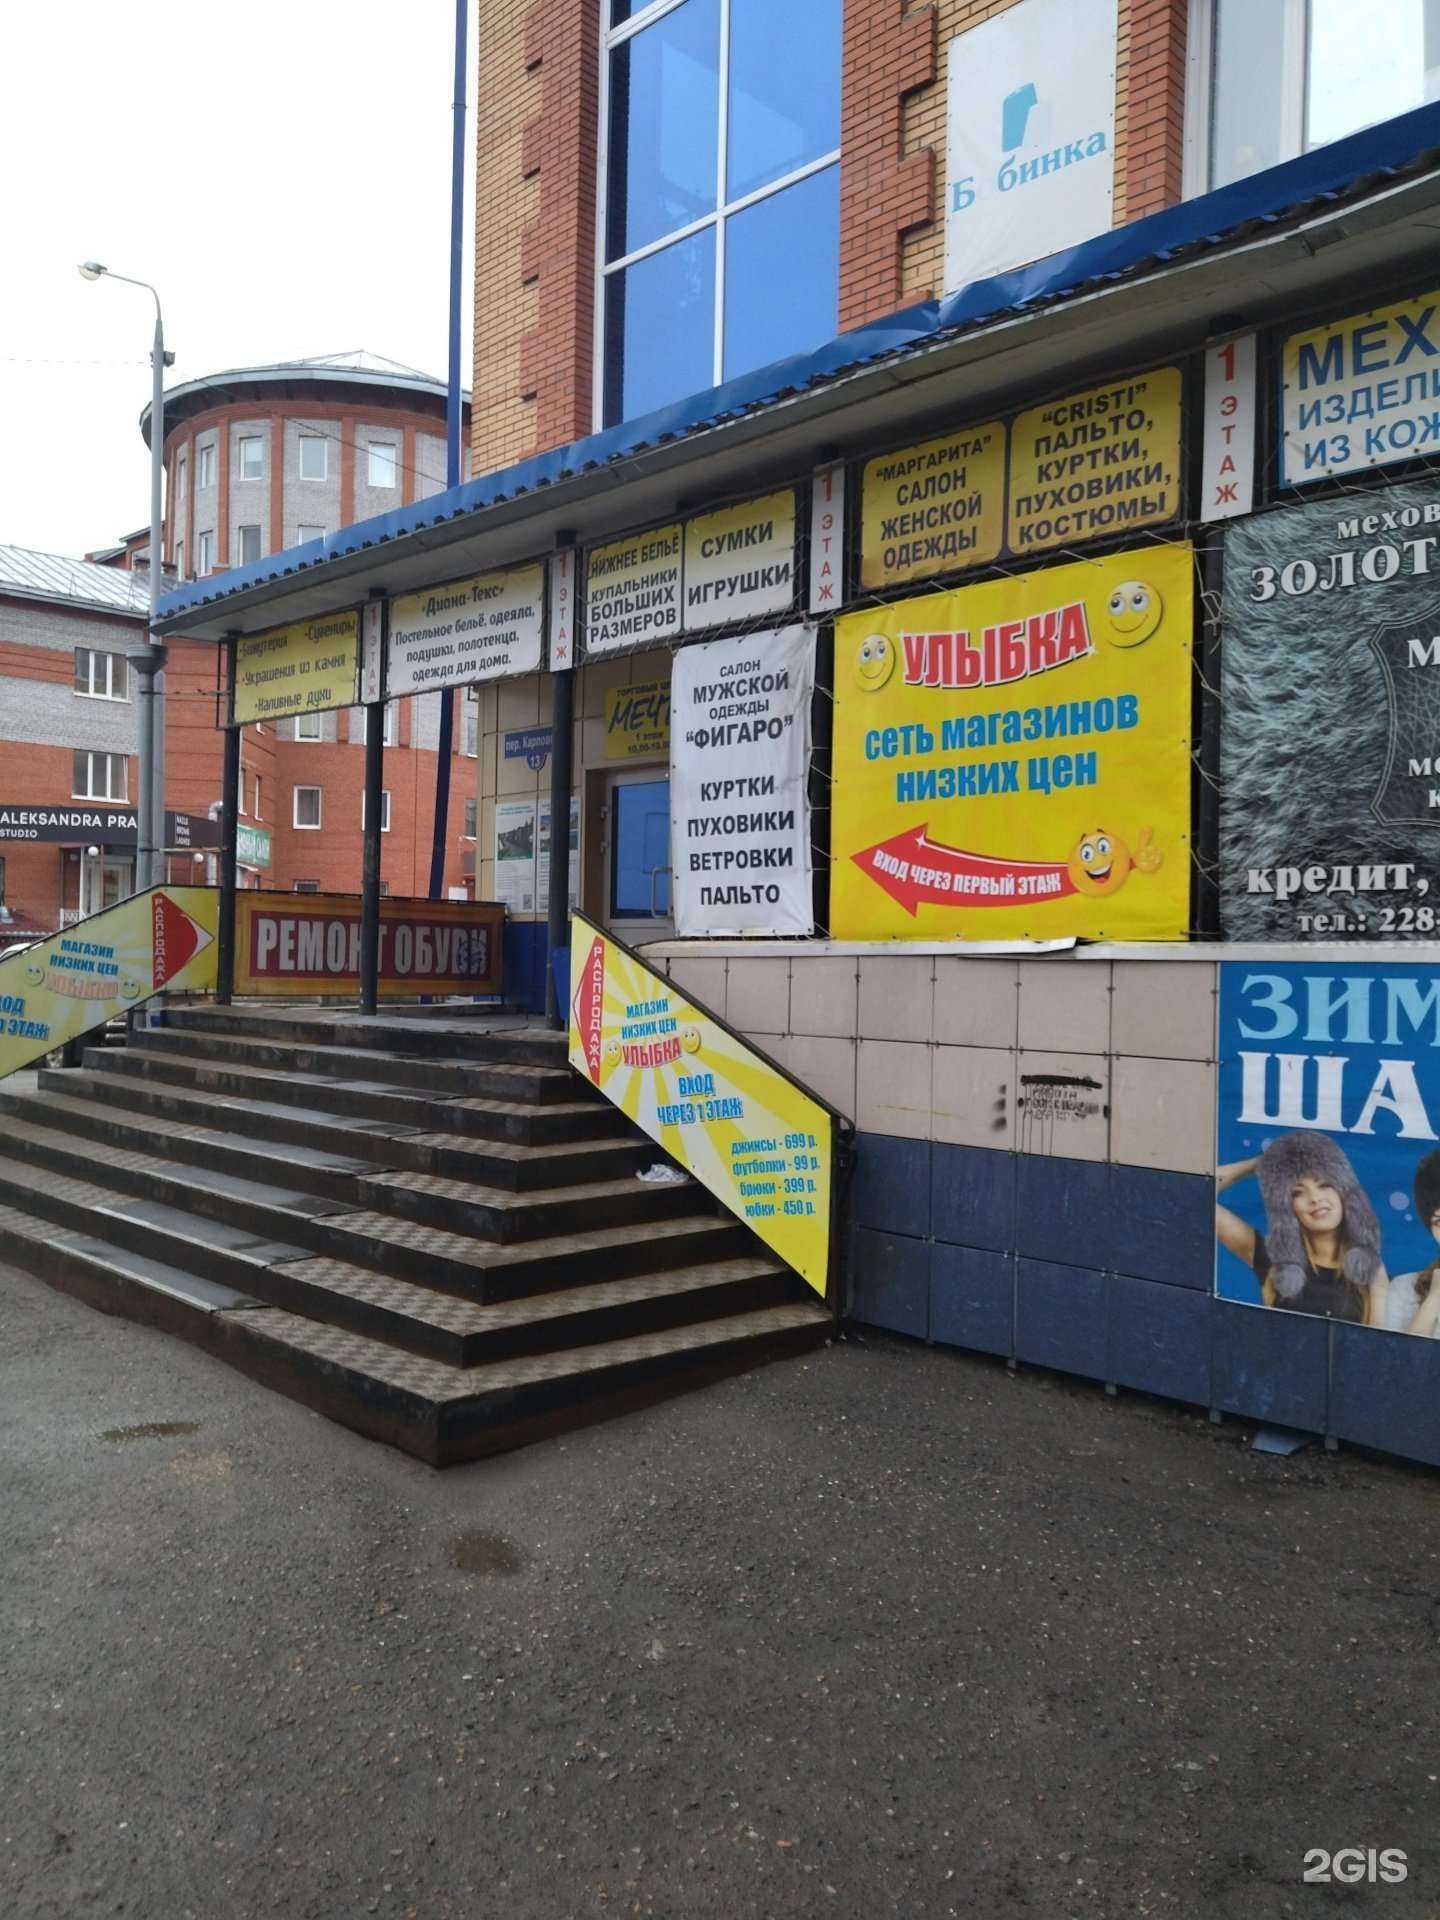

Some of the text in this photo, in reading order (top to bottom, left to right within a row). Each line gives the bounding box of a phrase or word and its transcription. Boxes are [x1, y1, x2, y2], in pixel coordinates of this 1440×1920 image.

[1035, 409, 1153, 458] ПАЛЬТО,
[1215, 343, 1239, 506] 1 ЭТАЖ
[1037, 438, 1148, 484] КУРТКИ,
[1304, 434, 1350, 470] ИЗ
[896, 467, 966, 505] САЛОН
[1015, 462, 1171, 517] ПУХОВИКИ,
[881, 488, 982, 540] ЖЕНСКОЙ
[1019, 492, 1166, 545] КОСТЮМЫ
[701, 520, 774, 559] СУМКИ
[818, 471, 833, 601] 1 ЭТАЖ
[883, 526, 977, 570] ОДЕЖДЫ
[591, 535, 680, 577] НИЖНЕЕ БЕЛЬЁ
[591, 567, 678, 604] КУПАЛЬНИКИ
[688, 562, 790, 606] ИГРУШКИ
[591, 585, 675, 623] БОЛЬШИХ
[395, 623, 453, 646] Постельное
[556, 587, 568, 660] ЭТАЖ
[590, 607, 677, 642] РАЗМЕРОВ
[901, 603, 1093, 687] УЛЫБКА
[300, 661, 310, 674] из
[412, 653, 511, 682] одежда для дома.
[719, 660, 761, 677] САЛОН
[306, 687, 332, 708] духи
[693, 668, 789, 704] МУЖСКОЙ
[709, 699, 770, 721] ОДЕЖДЫ
[865, 694, 1139, 760] сеть магазинов
[700, 776, 775, 801] КУРТКИ
[896, 751, 1097, 803] низких цен
[0, 811, 102, 827] ALEKSANDRA
[0, 828, 38, 838] STUDIO
[687, 810, 795, 837] ПУХОВИКИ
[689, 847, 793, 871] ВЕТРОВКИ
[871, 849, 1061, 896] ВХОД ЧЕРЕЗ ПЕРВЫЙ ЭТАЖ
[700, 884, 780, 905] ПАЛЬТО
[1246, 863, 1430, 900] кредит,
[1297, 913, 1367, 932] тел.:
[50, 954, 119, 977] НИЗКИХ ЦЕН
[60, 939, 114, 959] МАГАЗИН
[589, 946, 602, 1069] РАСПРОДАЖА
[626, 998, 669, 1018] МАГАЗИН
[1237, 974, 1440, 1047] ЗИМ
[7, 1018, 49, 1041] ЭТАЖ
[621, 1017, 677, 1039] НИЗКИХ ЦЕН
[622, 1037, 681, 1067] УЛЫБКА
[678, 1073, 714, 1096] ВХОД
[1236, 1051, 1440, 1141] ША
[656, 1096, 743, 1124] ЧЕРЕЗ 1 ЭТАЖ
[784, 1133, 806, 1149] 699
[794, 1156, 809, 1170] 99
[783, 1178, 805, 1193] 399
[783, 1200, 804, 1215] 450
